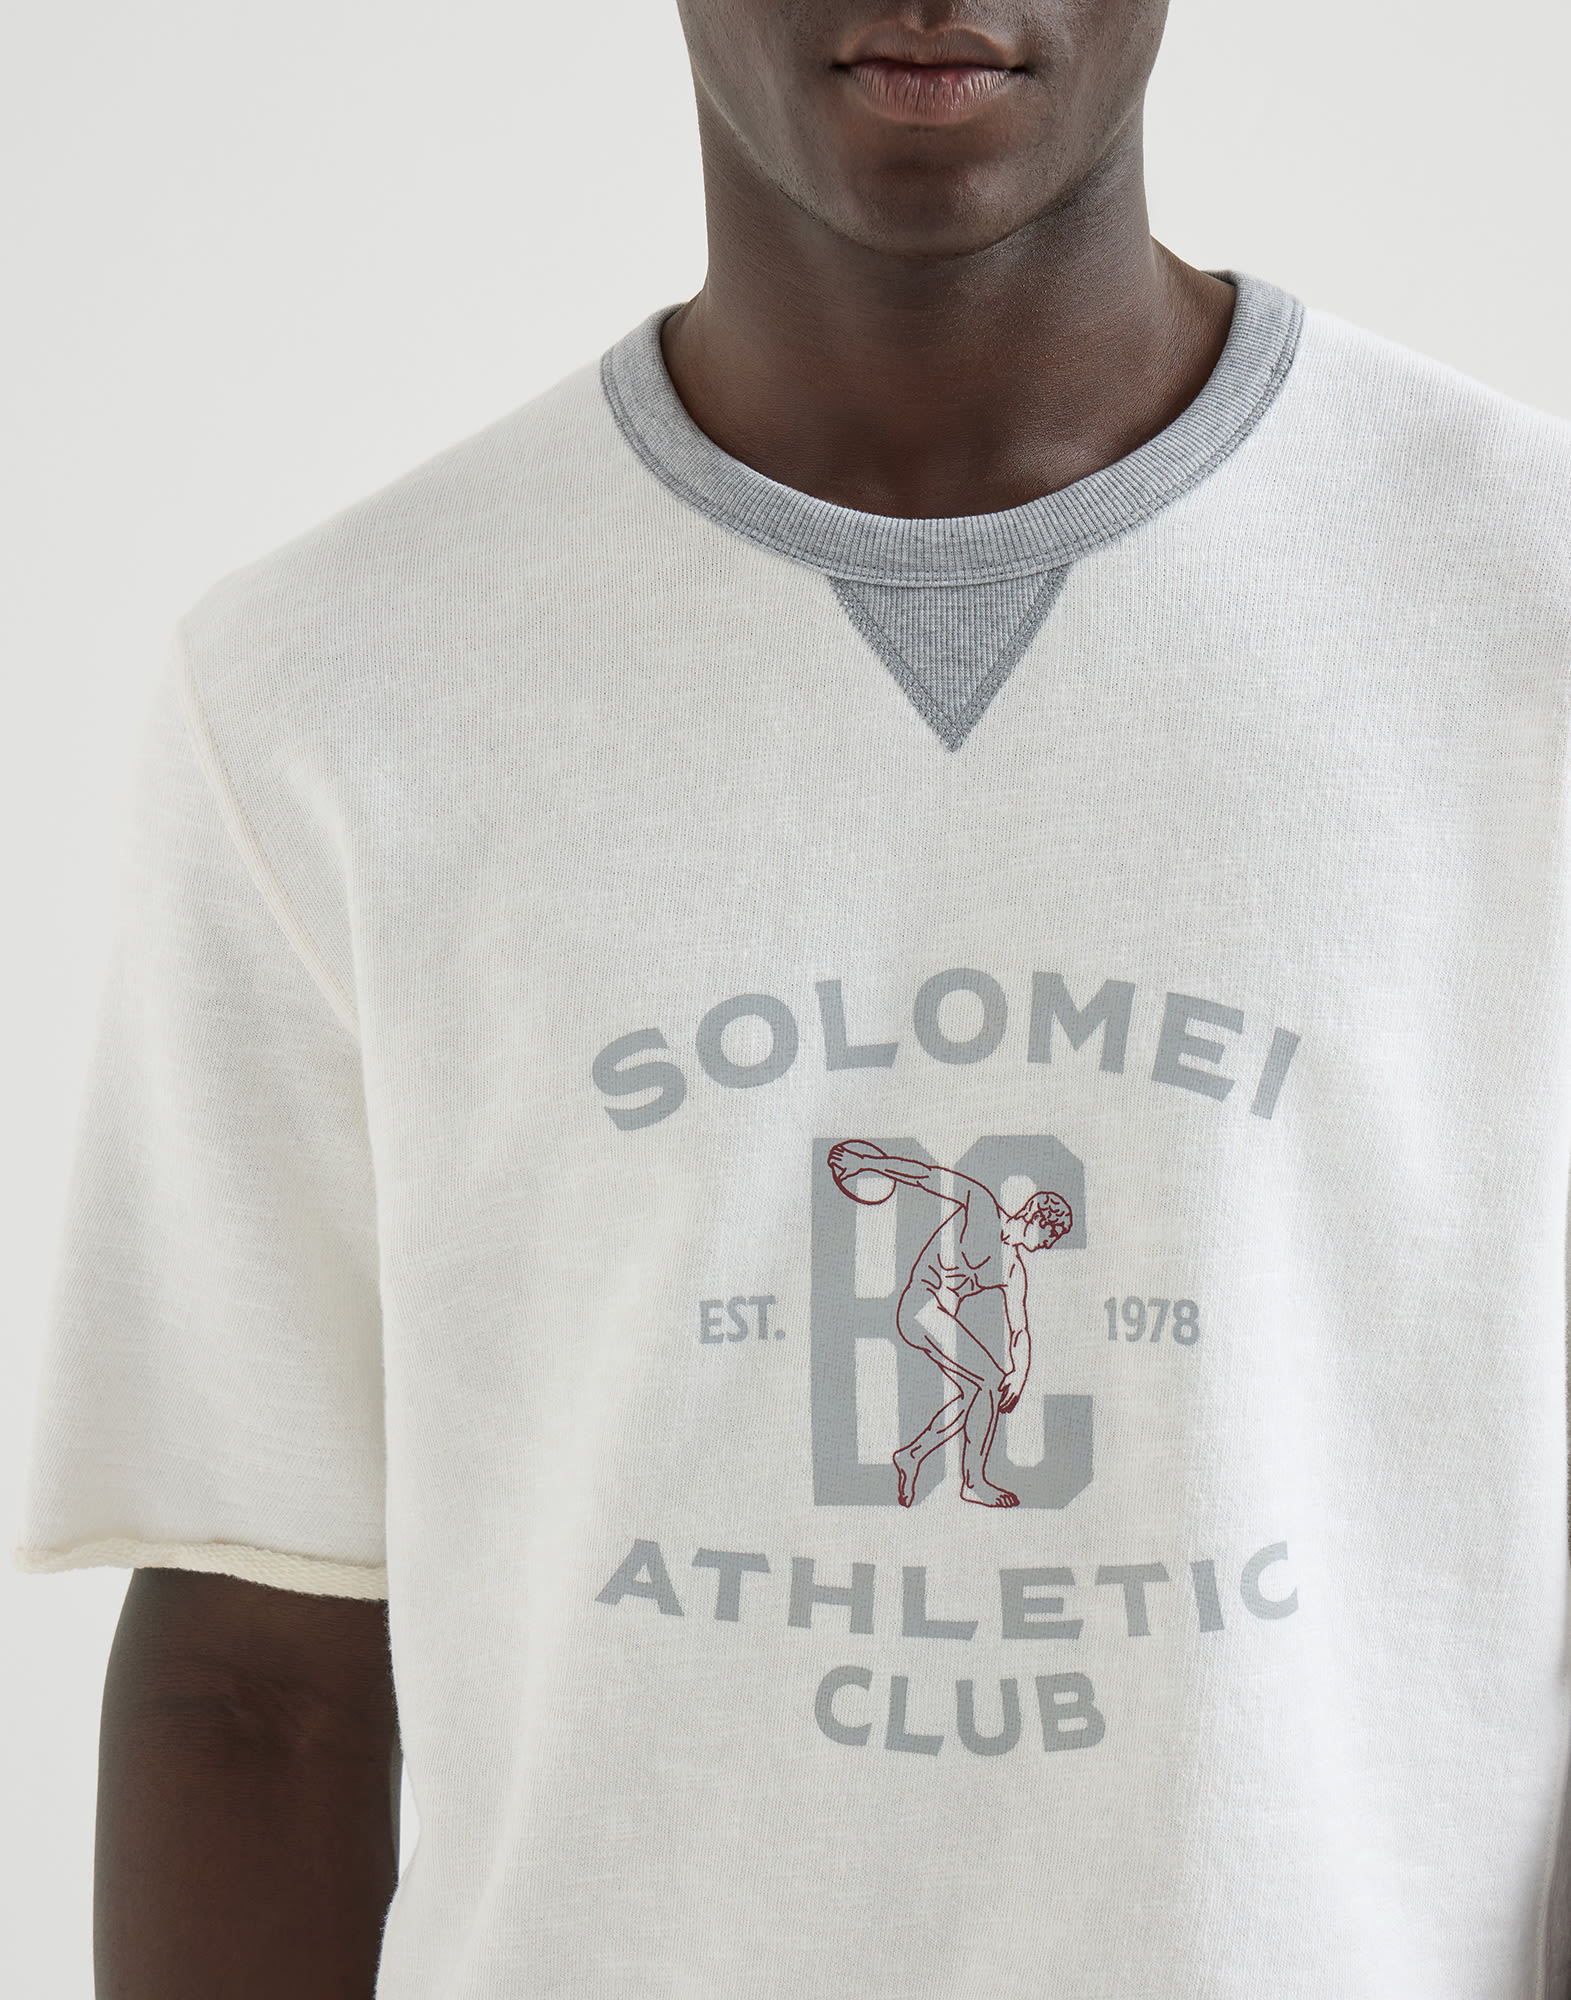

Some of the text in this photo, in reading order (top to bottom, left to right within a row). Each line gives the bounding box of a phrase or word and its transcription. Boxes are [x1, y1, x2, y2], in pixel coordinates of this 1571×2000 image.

[591, 968, 1302, 1131] SOLOMEI
[699, 1294, 1200, 1345] EST. 1978
[596, 1540, 1299, 1640] ATHLETIC
[814, 1666, 1105, 1757] CLUB
